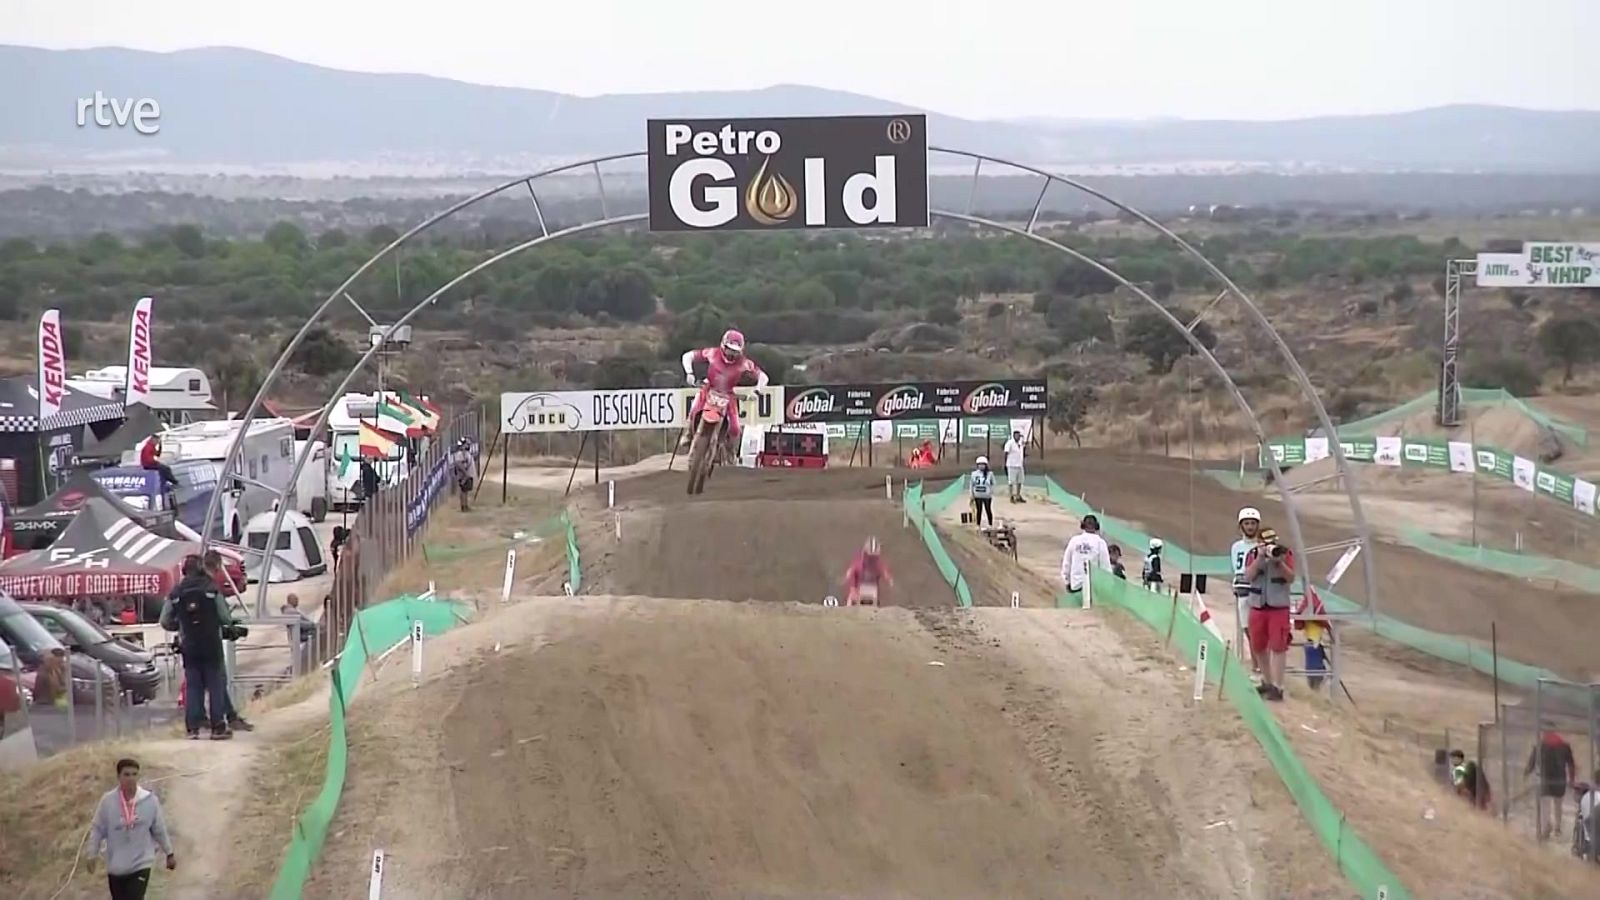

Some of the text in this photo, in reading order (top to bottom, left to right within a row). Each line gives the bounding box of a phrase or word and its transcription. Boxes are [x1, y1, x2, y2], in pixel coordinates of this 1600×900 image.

[665, 123, 781, 155] Petro
[1530, 246, 1574, 263] BEST
[1546, 266, 1593, 284] WHIP
[132, 309, 149, 394] KENDA
[42, 321, 63, 407] KENDA
[593, 392, 674, 426] DESGUACES
[793, 395, 835, 419] global
[883, 392, 924, 416] global
[970, 389, 1010, 412] global
[101, 476, 146, 487] YAMAHA
[14, 521, 57, 531] 24MX
[66, 575, 80, 595] OF
[121, 574, 160, 595] TIMES
